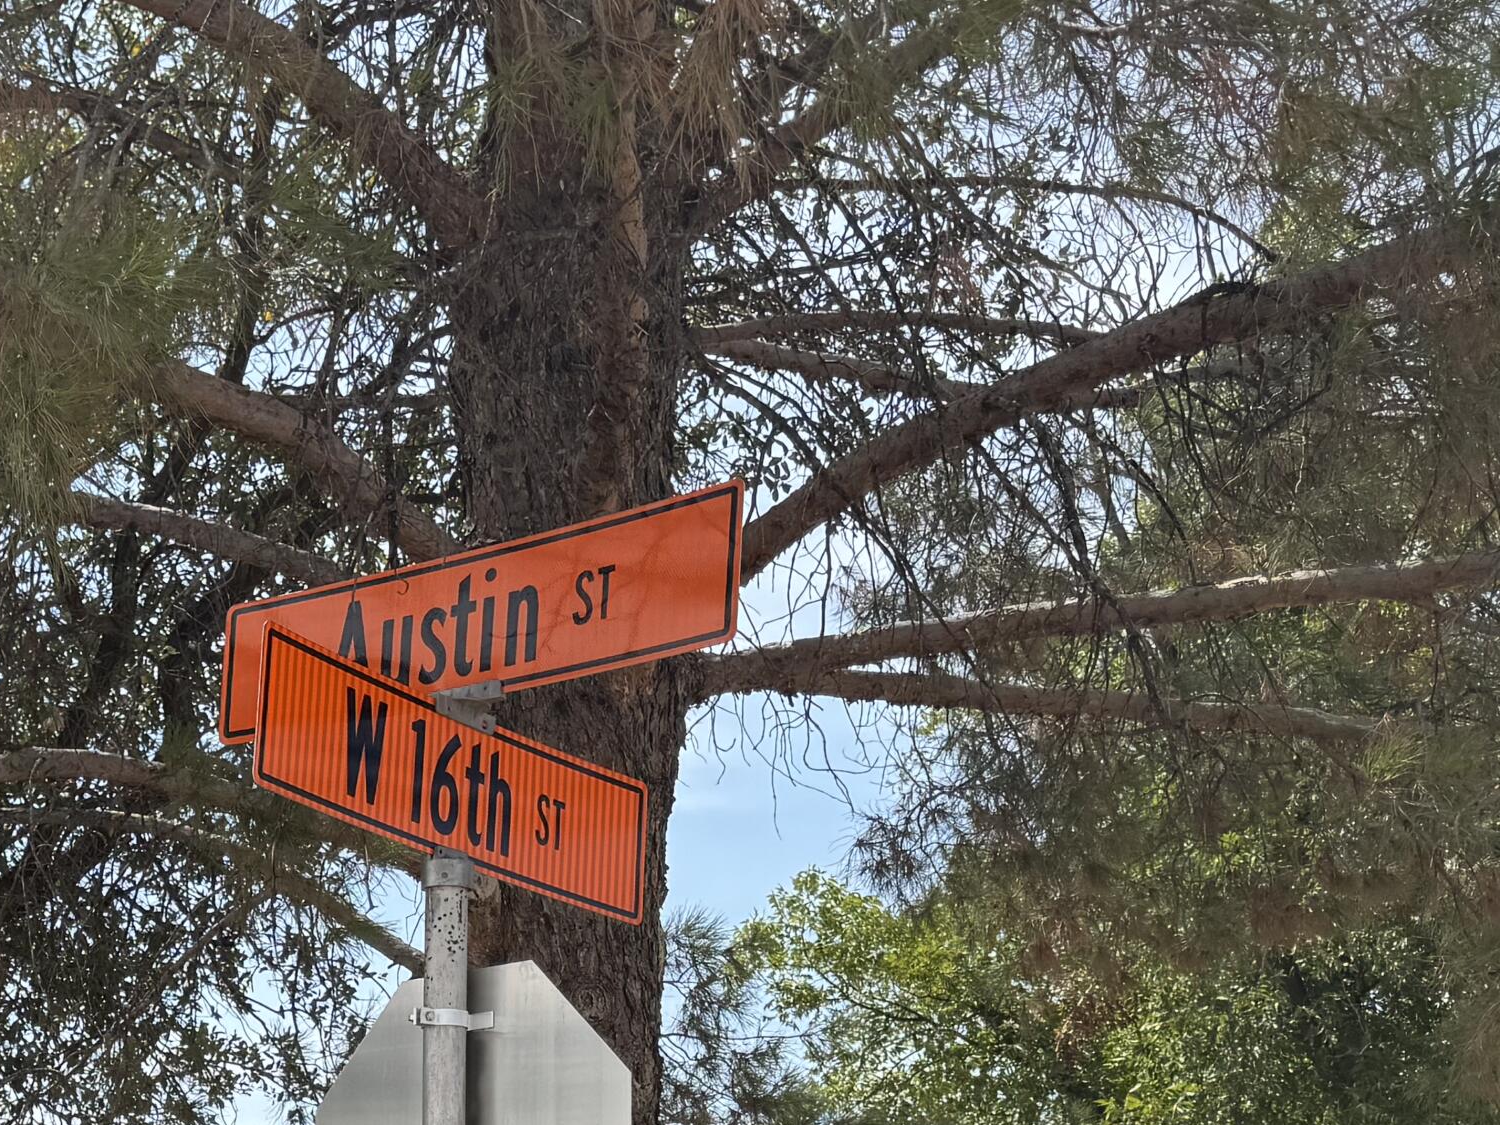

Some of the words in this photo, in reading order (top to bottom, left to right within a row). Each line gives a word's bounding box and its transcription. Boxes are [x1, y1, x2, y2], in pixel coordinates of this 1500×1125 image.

[338, 567, 539, 686] Austin
[572, 565, 615, 625] ST
[346, 687, 388, 804] W
[411, 719, 512, 857] 16th
[535, 794, 566, 850] ST
